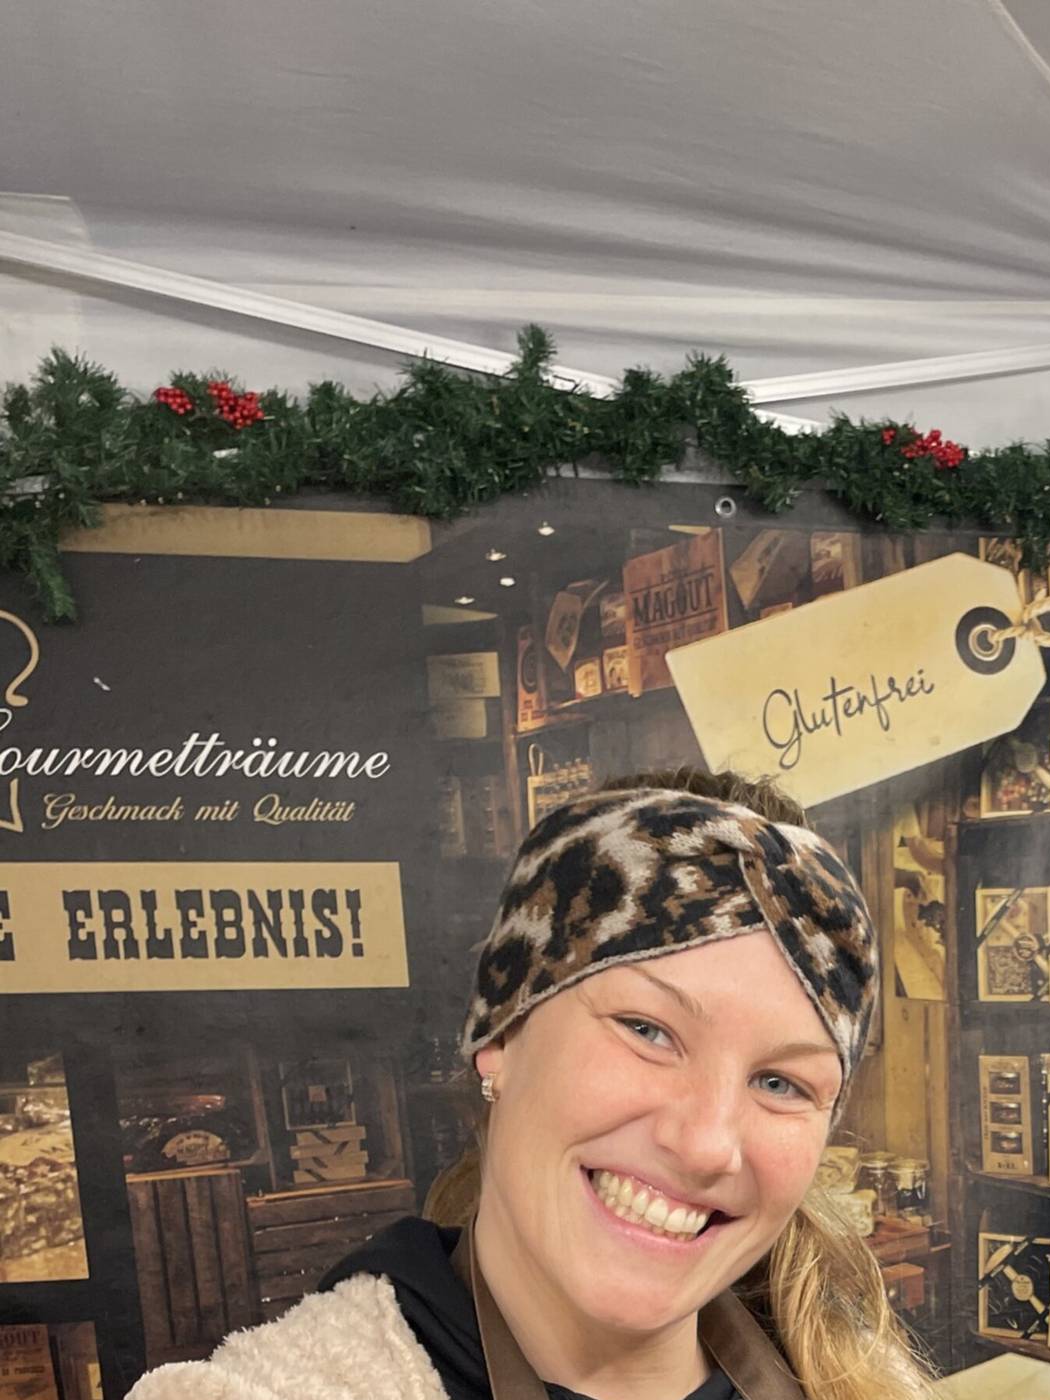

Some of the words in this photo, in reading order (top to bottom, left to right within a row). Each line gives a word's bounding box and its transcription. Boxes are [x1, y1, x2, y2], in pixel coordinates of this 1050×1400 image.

[0, 708, 391, 779] ourmetträume
[763, 669, 935, 770] Glutenfrei
[41, 792, 184, 829] Geschmack
[195, 799, 240, 822] mit
[253, 792, 356, 826] Qualität
[62, 888, 365, 960] ERLEBNIS!
